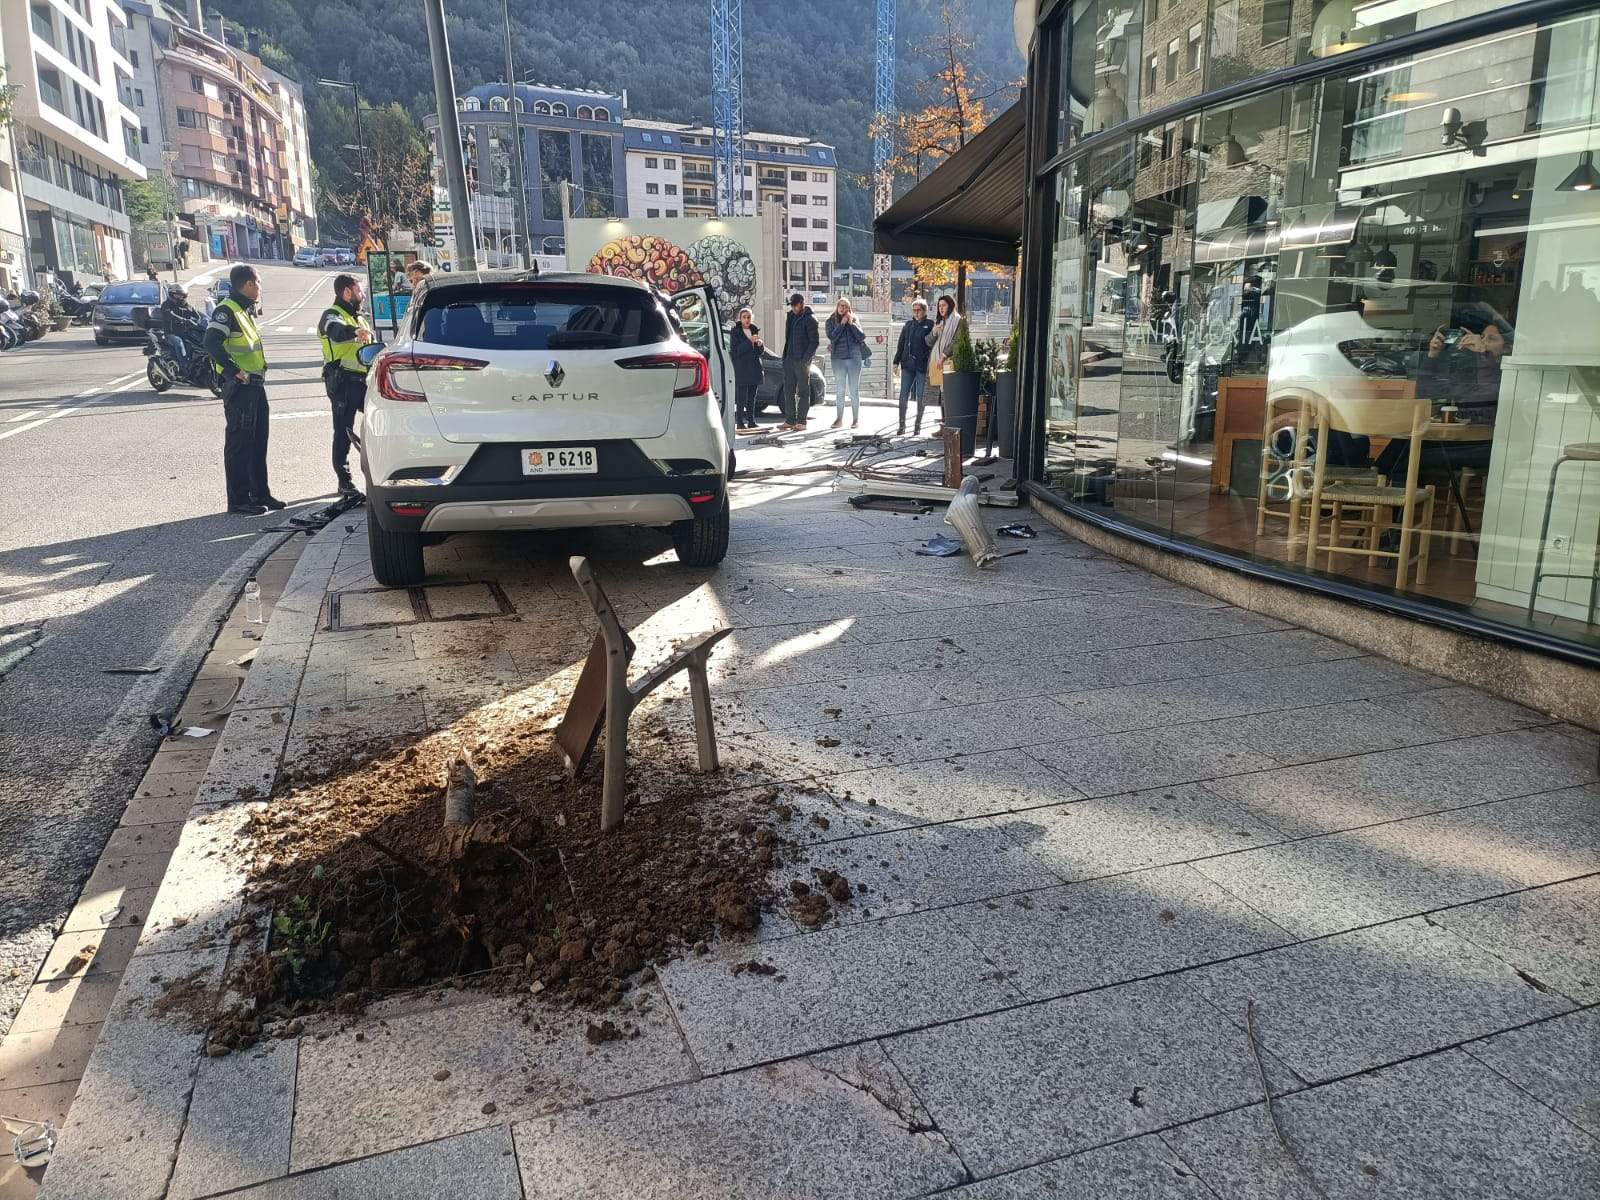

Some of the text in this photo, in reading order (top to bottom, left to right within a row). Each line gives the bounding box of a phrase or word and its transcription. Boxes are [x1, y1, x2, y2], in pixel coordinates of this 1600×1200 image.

[1125, 316, 1263, 345] ANTAGLORIA
[511, 393, 600, 402] CAPTUR
[547, 450, 593, 467] P 6218
